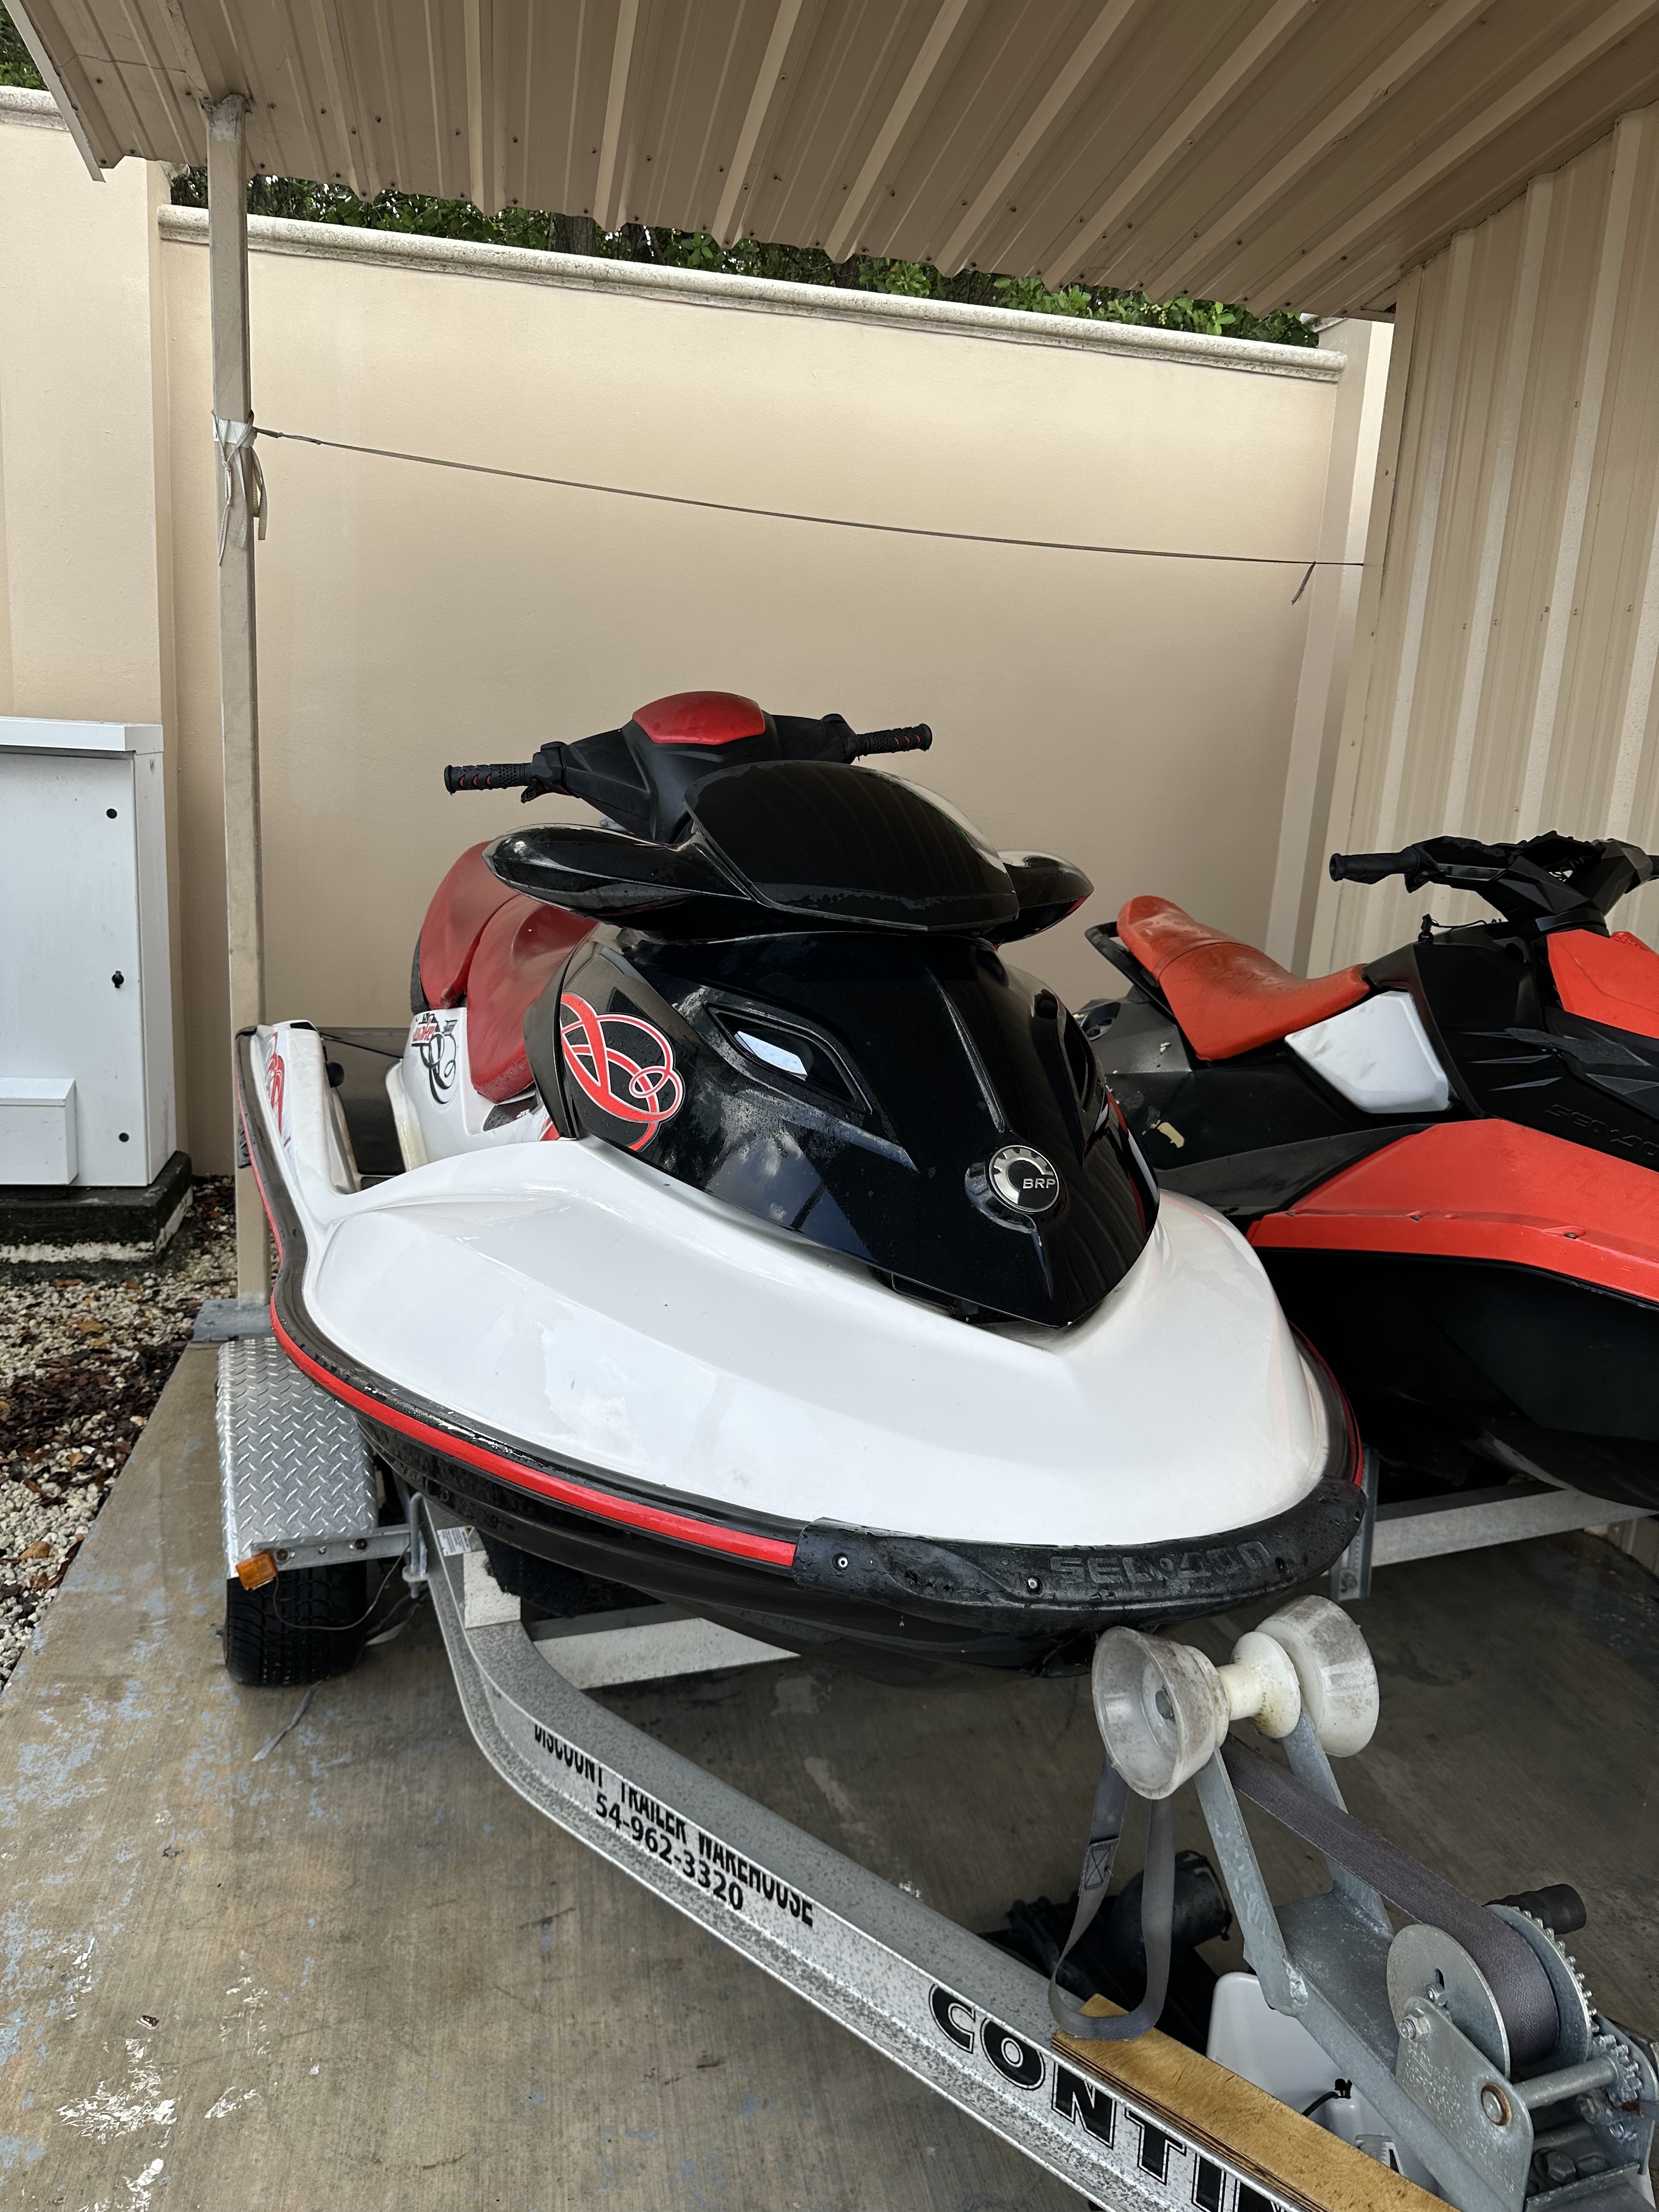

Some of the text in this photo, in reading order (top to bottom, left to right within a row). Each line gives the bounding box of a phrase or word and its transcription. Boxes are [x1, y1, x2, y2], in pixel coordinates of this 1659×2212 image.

[1023, 1178, 1056, 1189] BRP
[535, 1724, 813, 1928] DISCOUNT TRAILER WAREHOUSE
